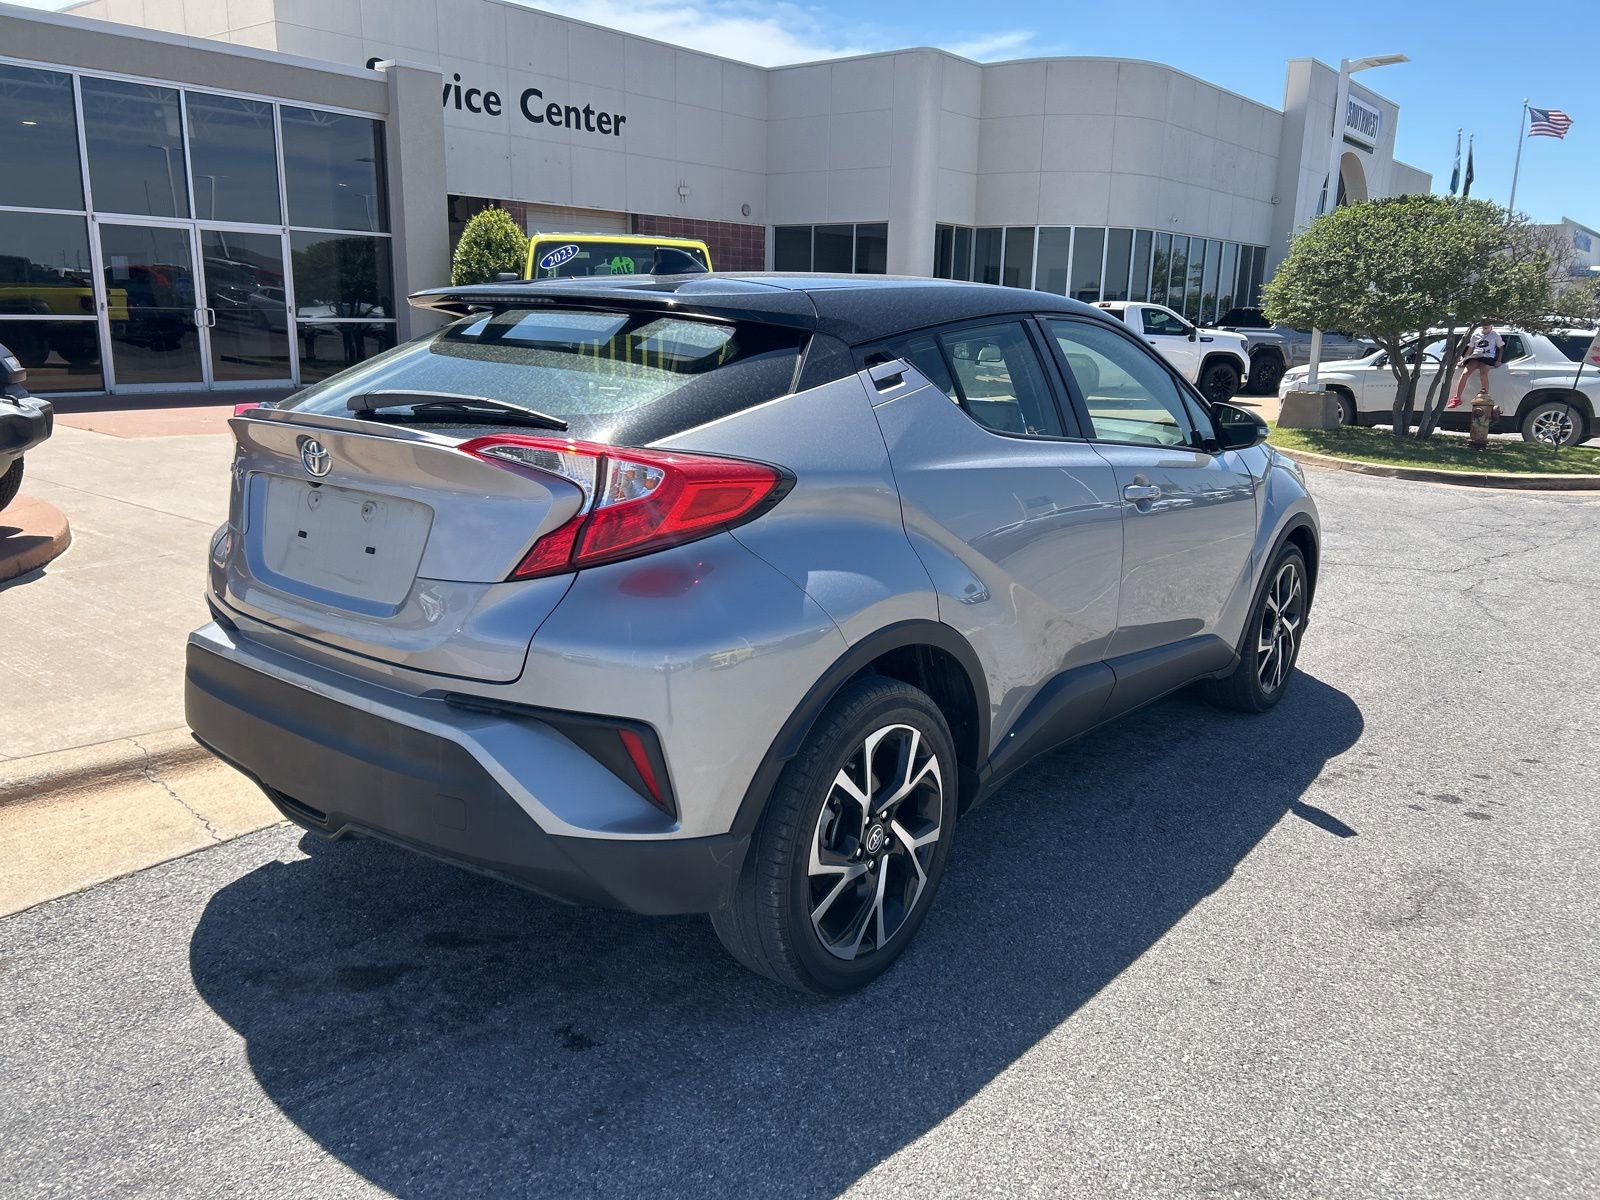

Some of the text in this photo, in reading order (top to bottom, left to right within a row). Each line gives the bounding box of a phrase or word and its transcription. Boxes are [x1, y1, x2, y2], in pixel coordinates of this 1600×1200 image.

[520, 88, 626, 136] Center
[1346, 100, 1379, 139] SOUTHWEST
[548, 246, 573, 266] 2023
[612, 263, 632, 274] SALE
